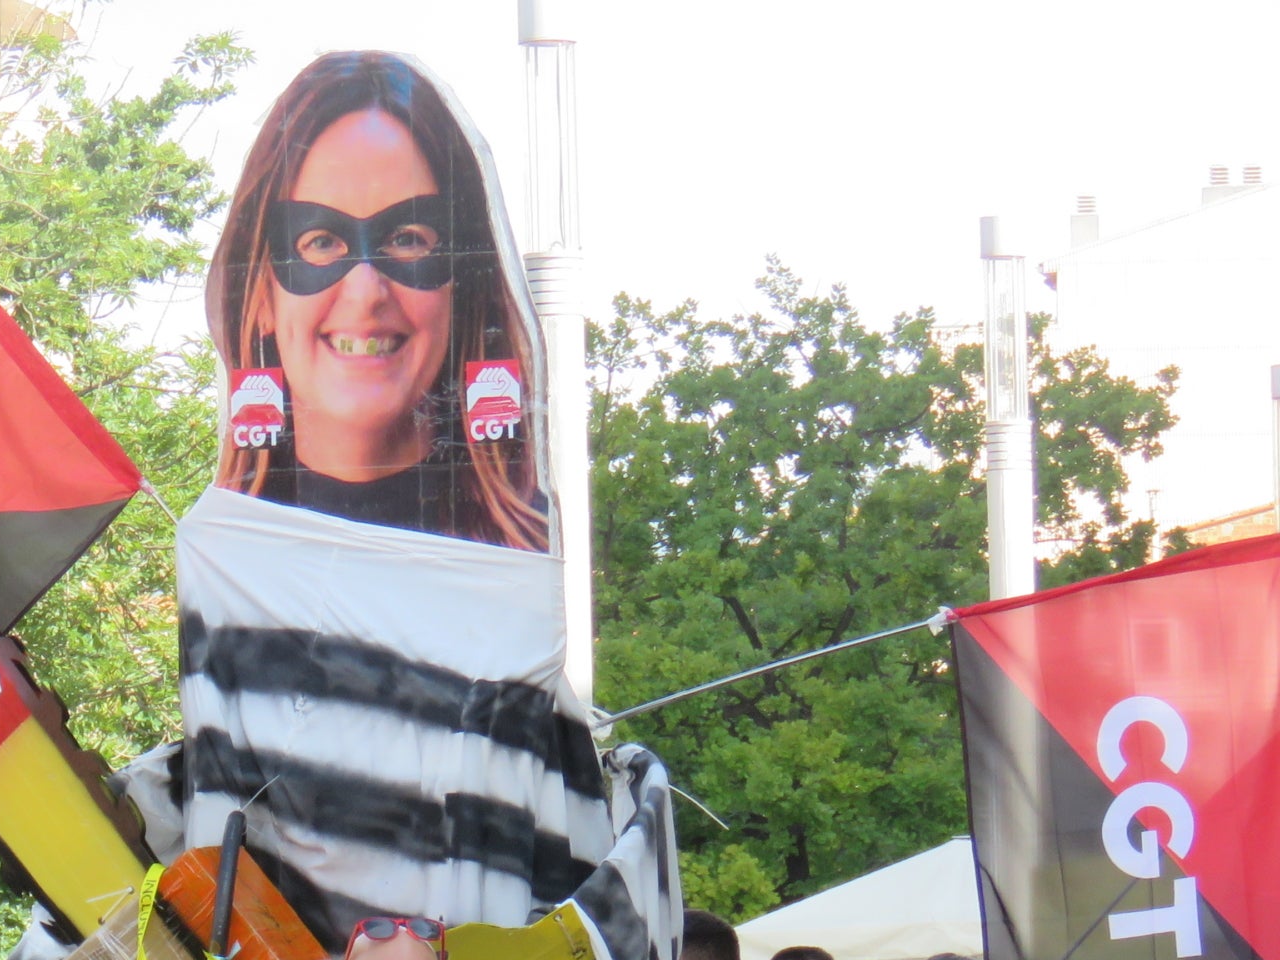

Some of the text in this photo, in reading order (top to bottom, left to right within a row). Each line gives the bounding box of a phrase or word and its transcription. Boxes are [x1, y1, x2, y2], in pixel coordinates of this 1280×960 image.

[233, 424, 282, 448] CGT
[470, 418, 519, 442] CGT
[1097, 696, 1202, 958] CGT
